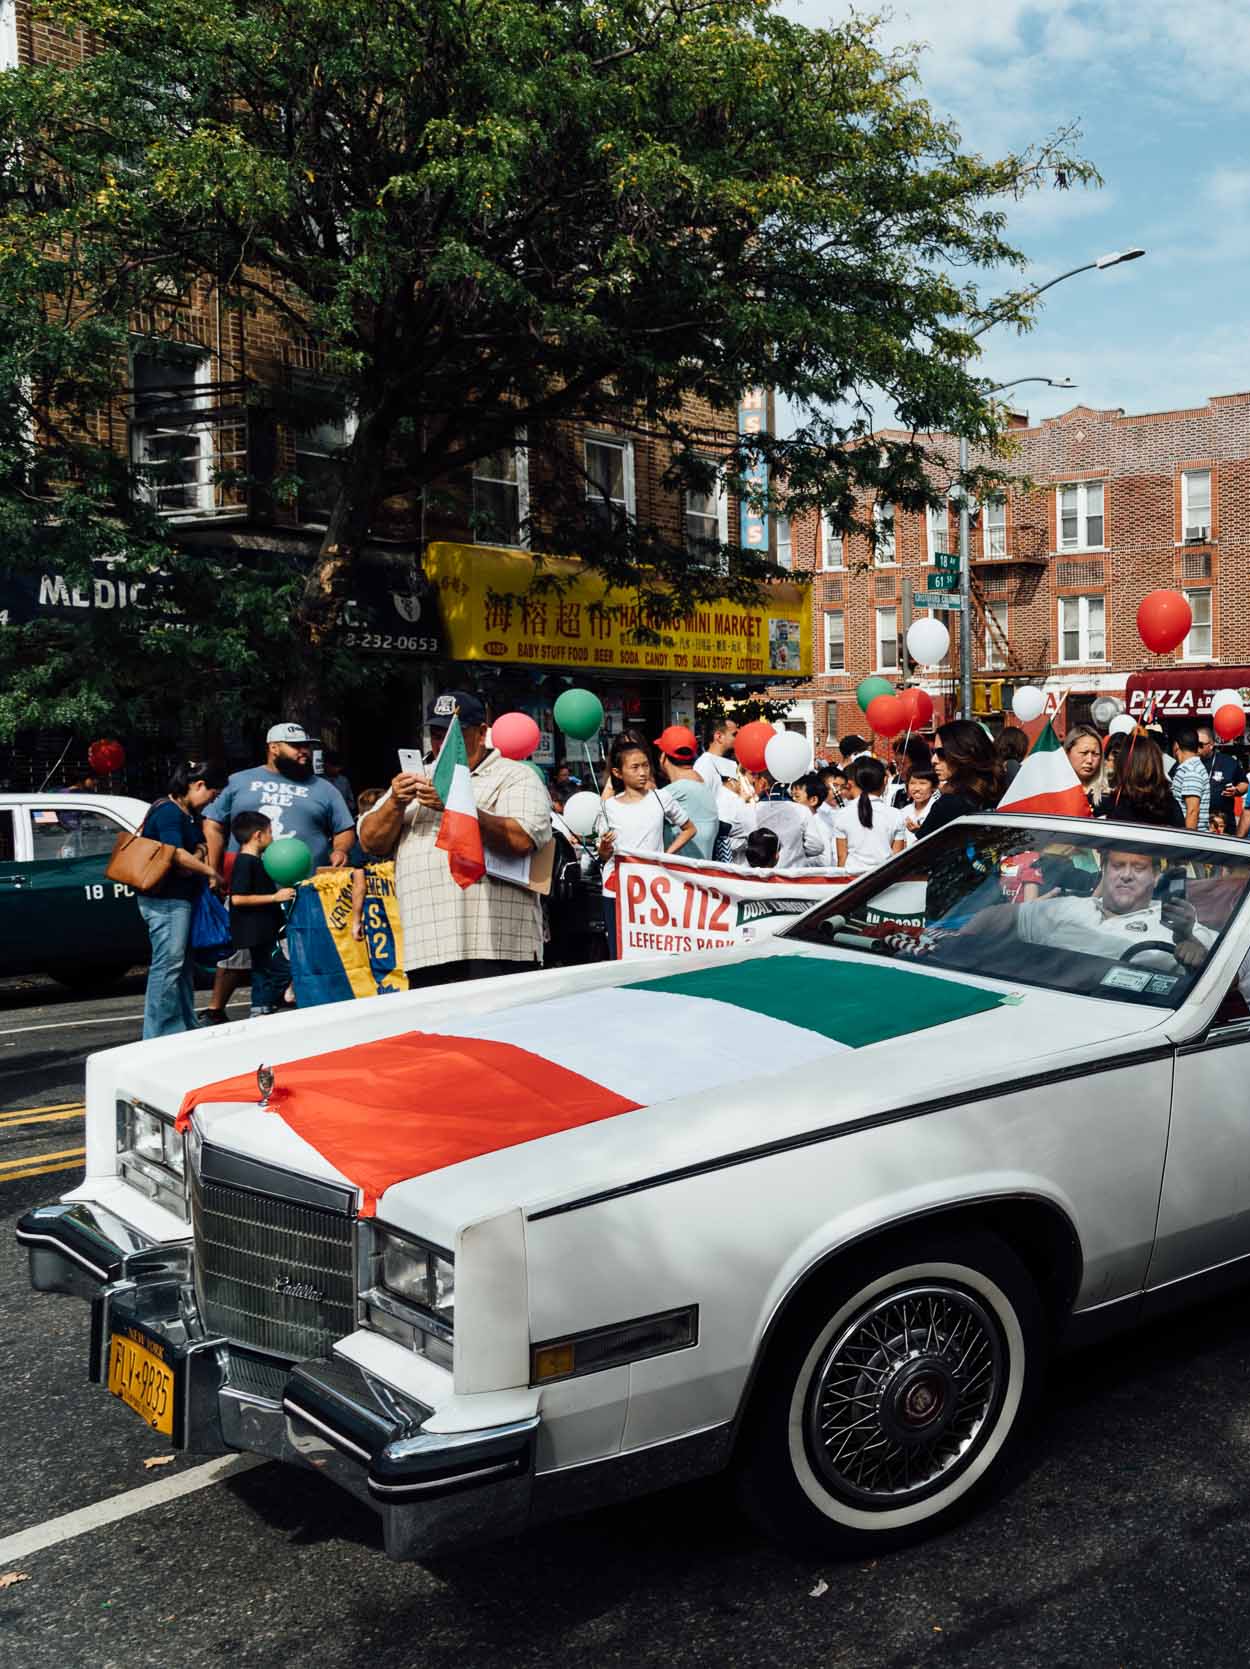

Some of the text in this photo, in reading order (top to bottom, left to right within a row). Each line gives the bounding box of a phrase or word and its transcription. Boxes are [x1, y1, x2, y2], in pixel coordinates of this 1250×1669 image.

[935, 576, 944, 588] 61
[684, 609, 711, 633] MINI
[714, 613, 762, 638] MARKET
[518, 643, 540, 657] BABY
[541, 644, 567, 659] STUFF
[568, 647, 588, 661] FOOD
[595, 648, 613, 662] BEER
[620, 650, 639, 665] SODA
[645, 652, 668, 667] CANDY
[674, 654, 688, 667] TOYS
[693, 656, 710, 669] DAILY
[711, 656, 732, 670] STUFF
[737, 658, 763, 672] LOTTERY
[1130, 690, 1193, 708] PIZZA
[250, 781, 309, 798] POKE
[261, 792, 293, 807] ME
[84, 884, 104, 900] 18
[627, 874, 731, 932] P.S. 112
[743, 901, 772, 920] DUAL
[629, 931, 692, 952] LEFFERTS
